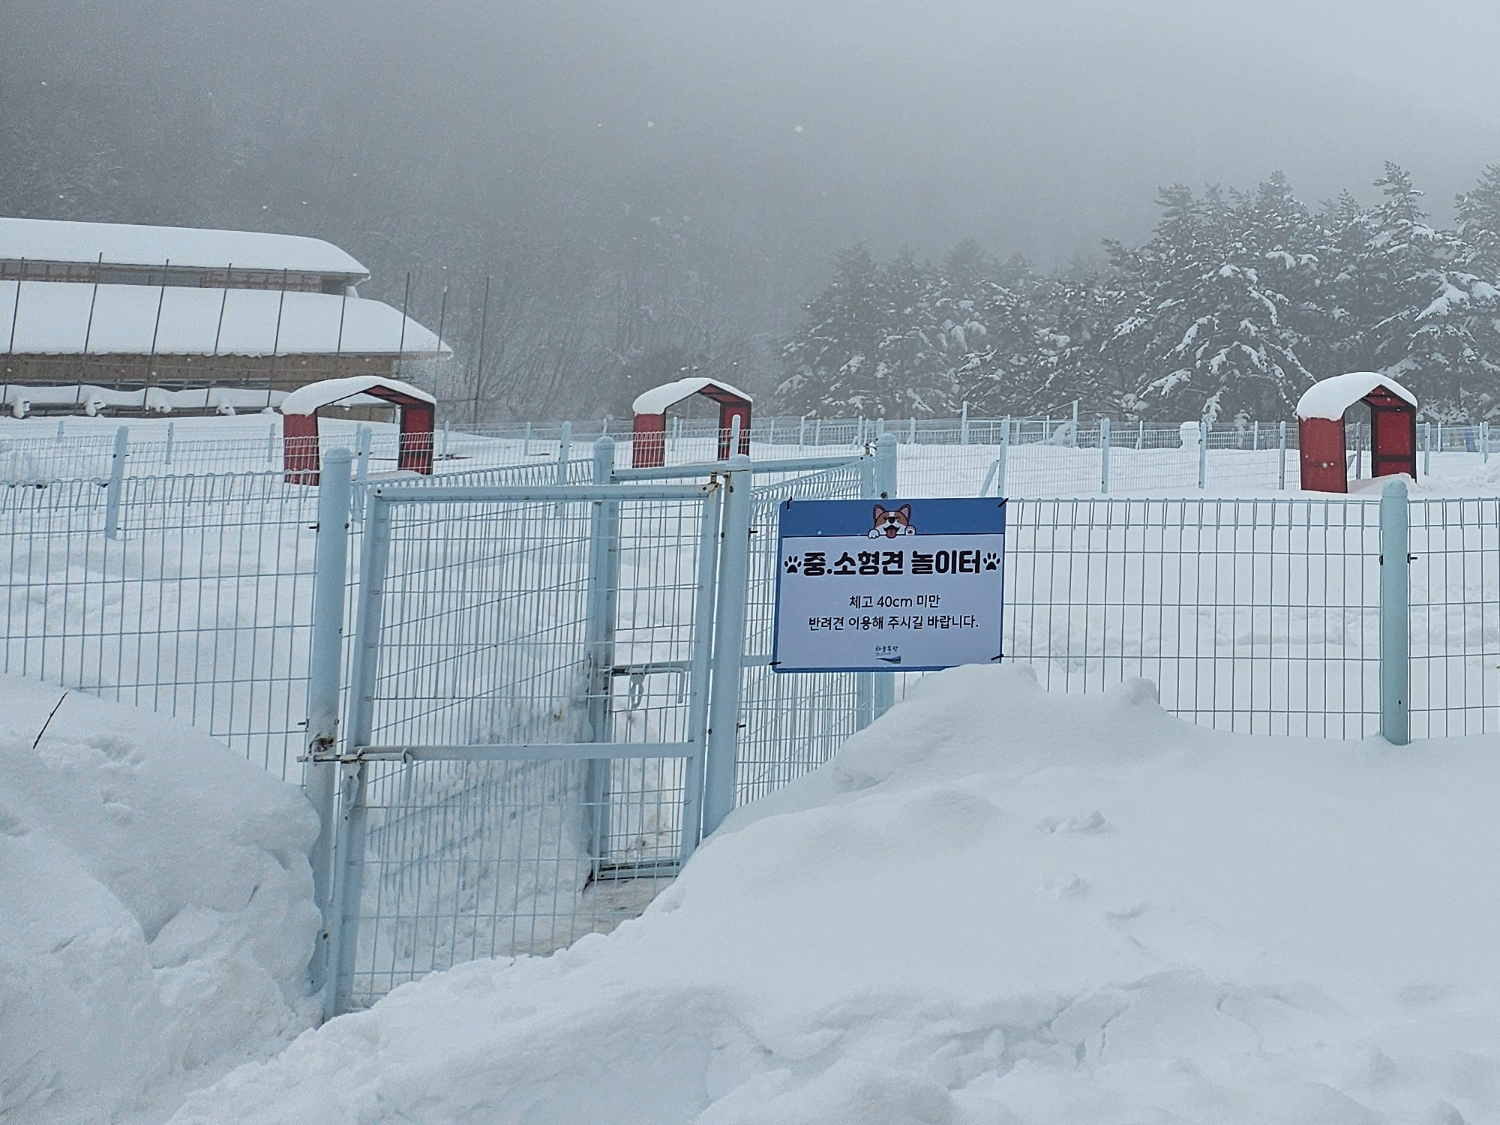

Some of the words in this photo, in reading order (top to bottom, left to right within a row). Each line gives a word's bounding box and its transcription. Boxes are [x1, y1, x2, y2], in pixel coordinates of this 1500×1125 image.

[803, 550, 904, 576] 중.소형견
[911, 549, 981, 575] 놀이터
[849, 595, 874, 609] 체고
[876, 595, 913, 608] 40cm
[916, 594, 941, 608] 미만
[808, 616, 845, 631] 반려견
[848, 615, 884, 631] 이용해
[887, 615, 924, 630] 주시길
[927, 614, 980, 629] 바랍니다.
